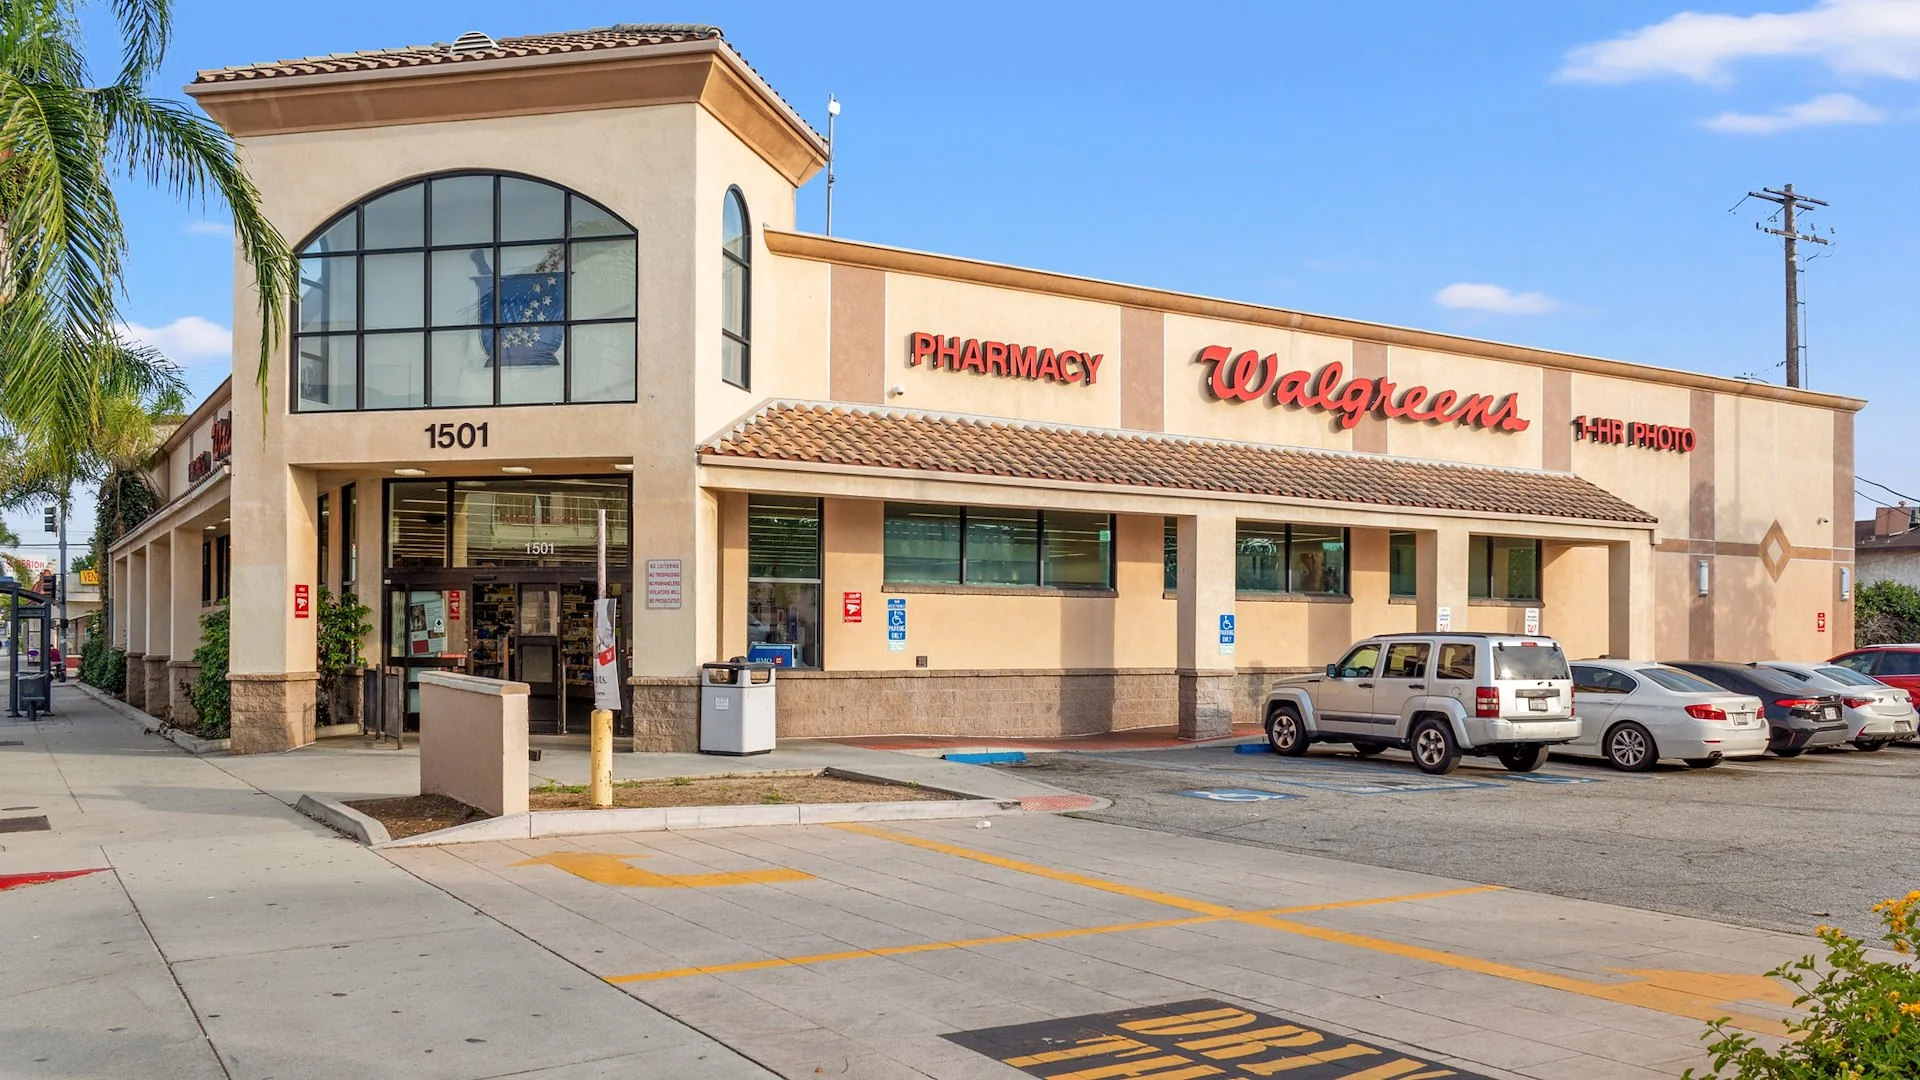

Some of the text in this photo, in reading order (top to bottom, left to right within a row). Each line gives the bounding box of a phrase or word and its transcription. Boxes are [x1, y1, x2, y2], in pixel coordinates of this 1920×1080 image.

[911, 332, 1104, 385] PHARMACY
[1199, 345, 1531, 432] Walgreens
[424, 422, 488, 449] 1501
[1574, 415, 1697, 453] 1-HR PHOTO
[524, 542, 555, 555] 1501
